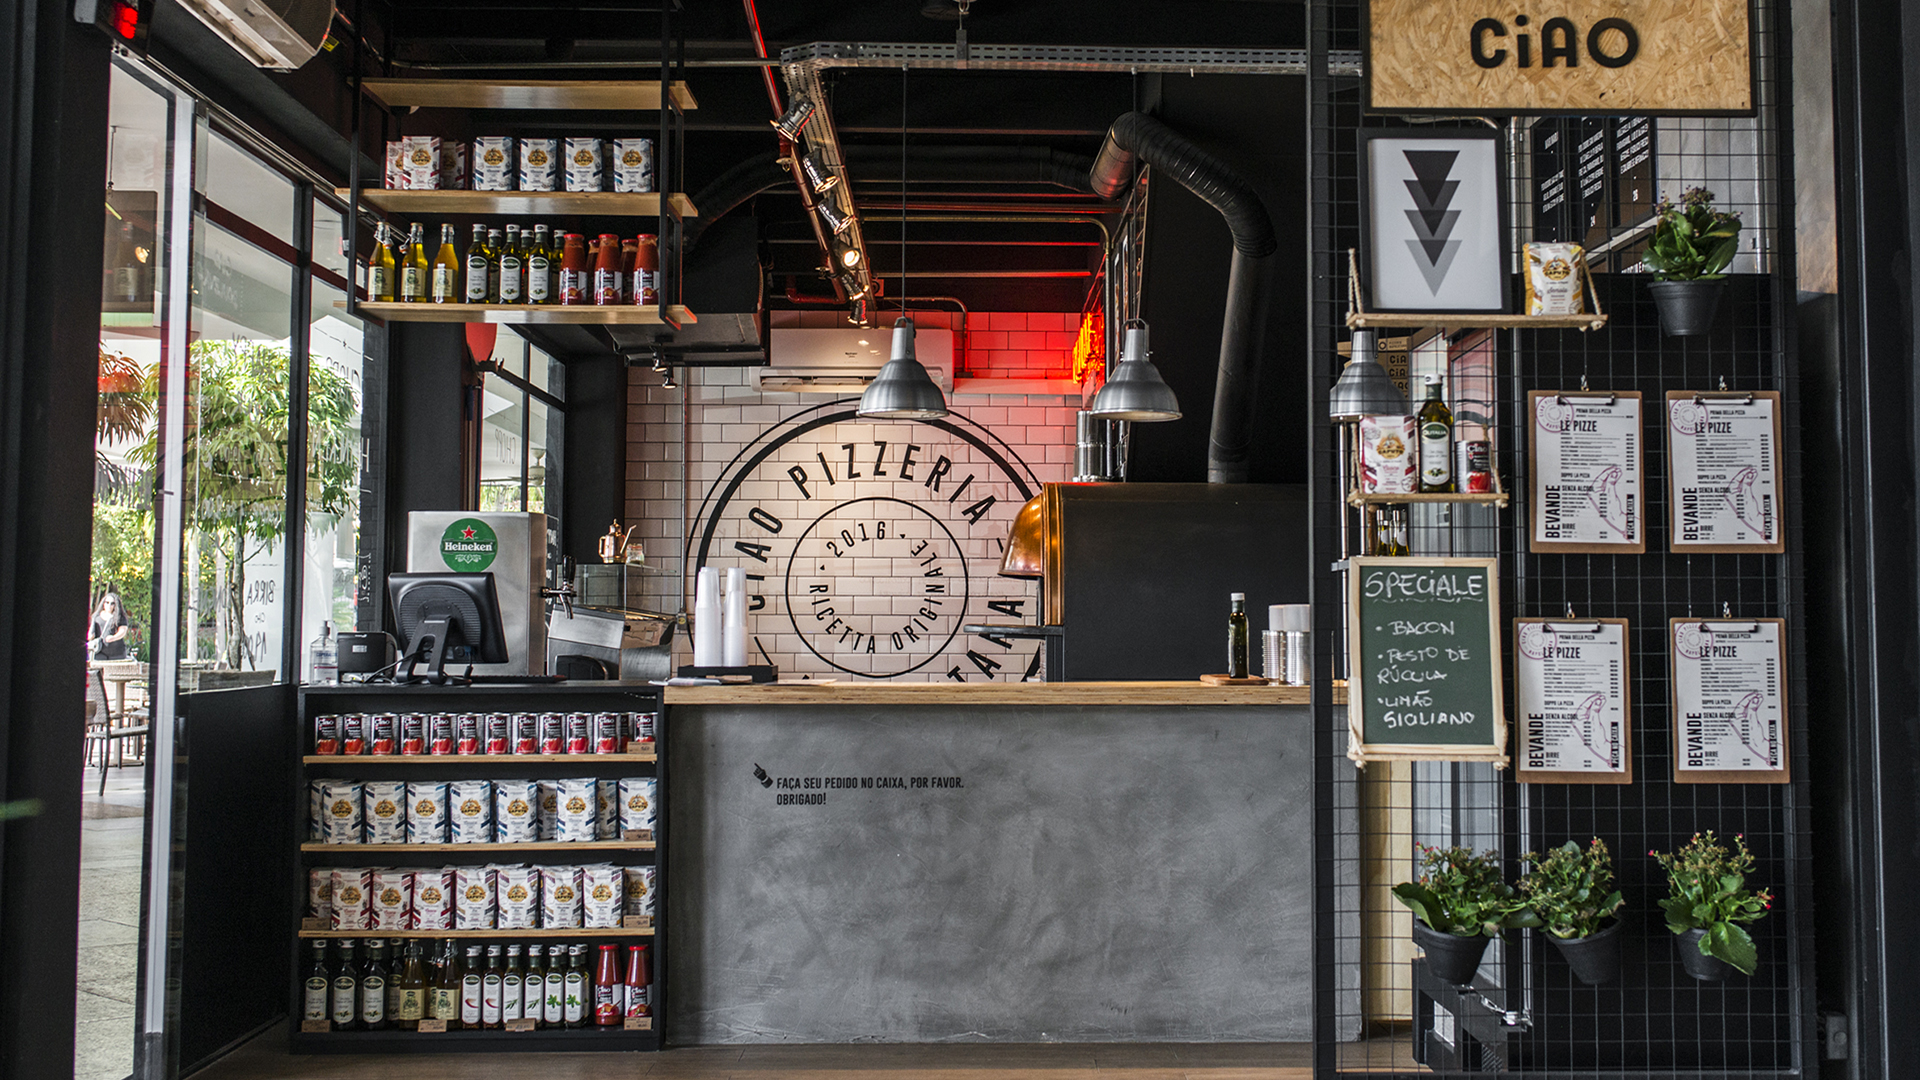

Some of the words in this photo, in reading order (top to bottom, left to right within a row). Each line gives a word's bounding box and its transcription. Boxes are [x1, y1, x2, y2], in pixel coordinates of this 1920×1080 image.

[1389, 355, 1407, 364] CiA
[1388, 368, 1406, 377] CiA
[1560, 420, 1570, 431] LE
[1573, 420, 1597, 432] PIZZE
[1695, 422, 1705, 433] LE
[1708, 422, 1732, 433] PIZZE
[787, 441, 997, 525] PIZZERIA
[1545, 485, 1560, 538] BEVANDE
[1682, 488, 1698, 540] BEVANDE
[444, 541, 493, 552] Heineken
[826, 521, 886, 558] 2016
[809, 584, 876, 654] RICETTA
[891, 540, 945, 651] ORIGINALE
[1387, 620, 1455, 636] BACON
[1386, 646, 1439, 664] PESTO
[1445, 648, 1471, 662] DE
[1543, 647, 1553, 658] LE
[1557, 647, 1580, 658] PIZZE
[1700, 646, 1710, 657] LE
[1713, 646, 1737, 657] PIZZE
[1385, 689, 1433, 708] LIMÃO
[1528, 713, 1544, 767] BEVANDE
[1686, 712, 1703, 766] BEVANDE
[776, 777, 801, 790] FAÇA
[803, 777, 821, 789] SEU
[824, 777, 858, 789] PEDIDO
[861, 777, 874, 789] NO
[876, 777, 907, 791] CAIXA,
[910, 777, 928, 789] POR
[931, 777, 964, 789] FAVOR.
[776, 793, 827, 805] OBRIGADO!
